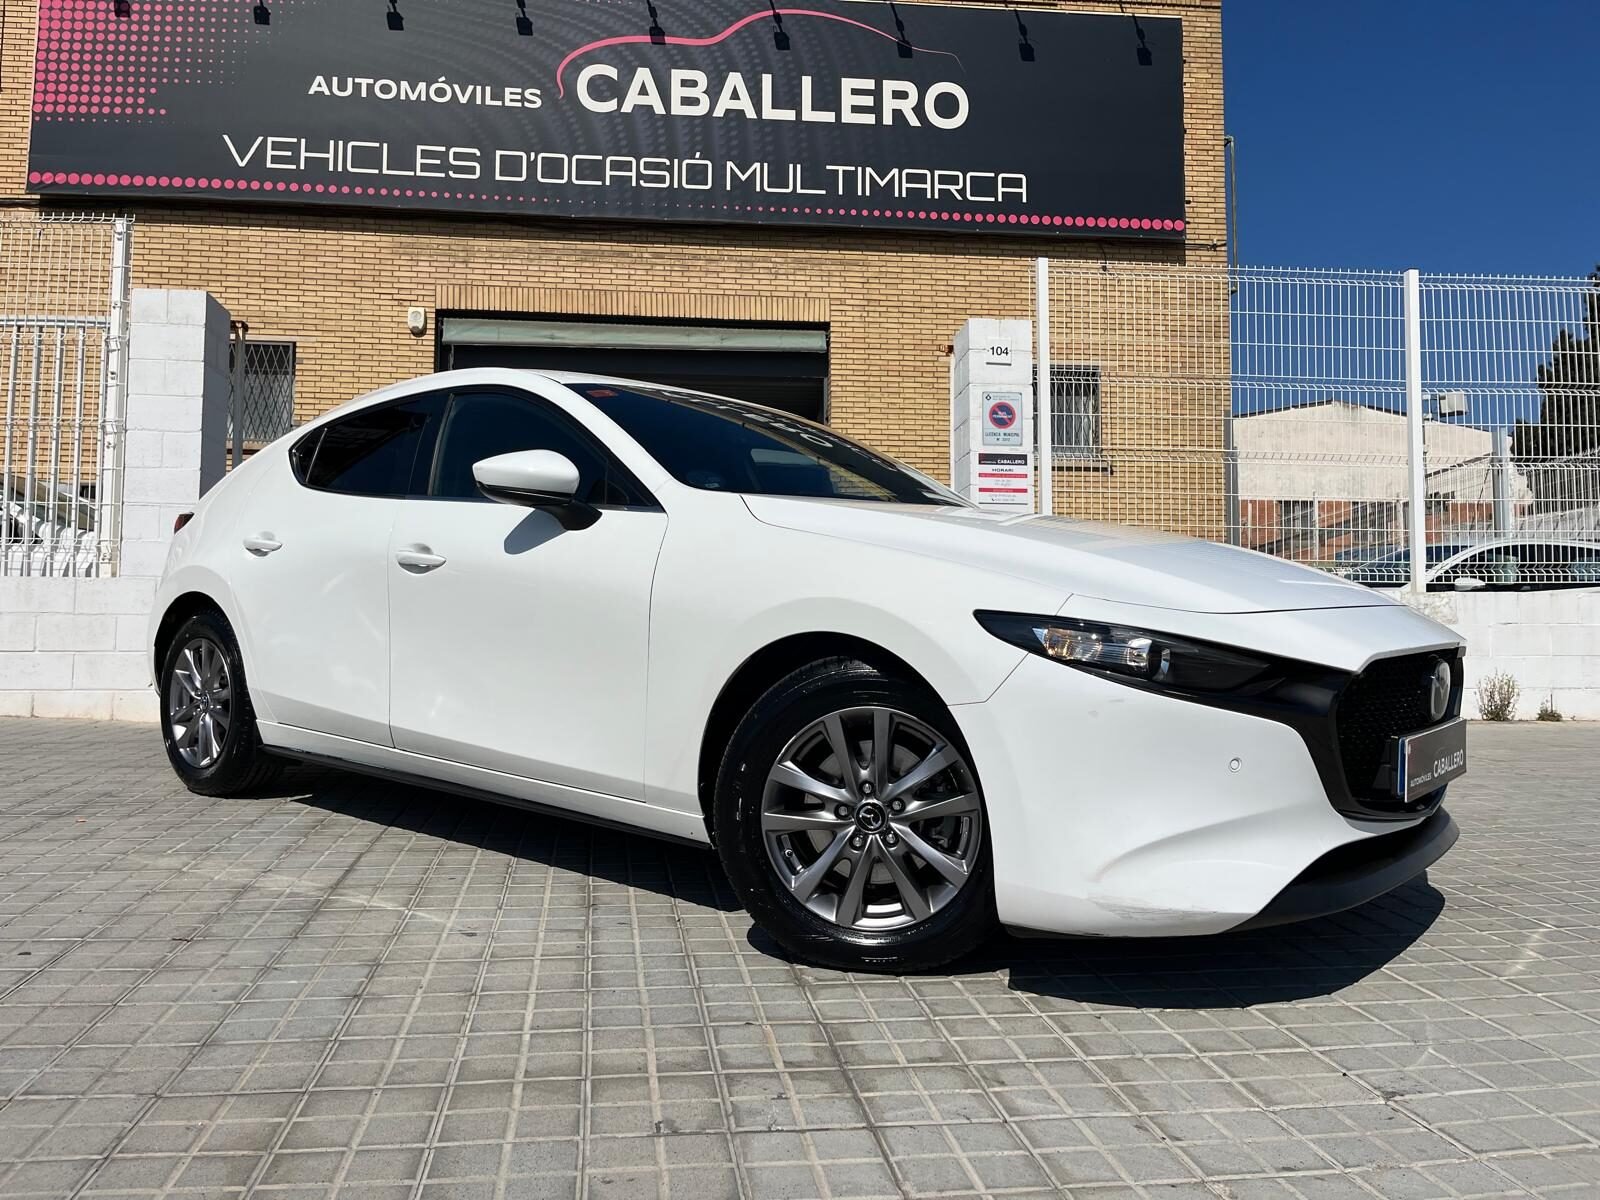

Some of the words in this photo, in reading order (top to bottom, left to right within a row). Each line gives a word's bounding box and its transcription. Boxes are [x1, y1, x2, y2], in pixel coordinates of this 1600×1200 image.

[308, 76, 542, 109] AUTOMÓVILES
[577, 64, 969, 130] CABALLERO
[222, 134, 481, 180] VEHICLES
[495, 149, 713, 190] D'OCASIÓ
[726, 161, 1027, 203] MULTIMARCA
[989, 345, 1009, 356] 104
[1433, 749, 1464, 778] CABALLERO
